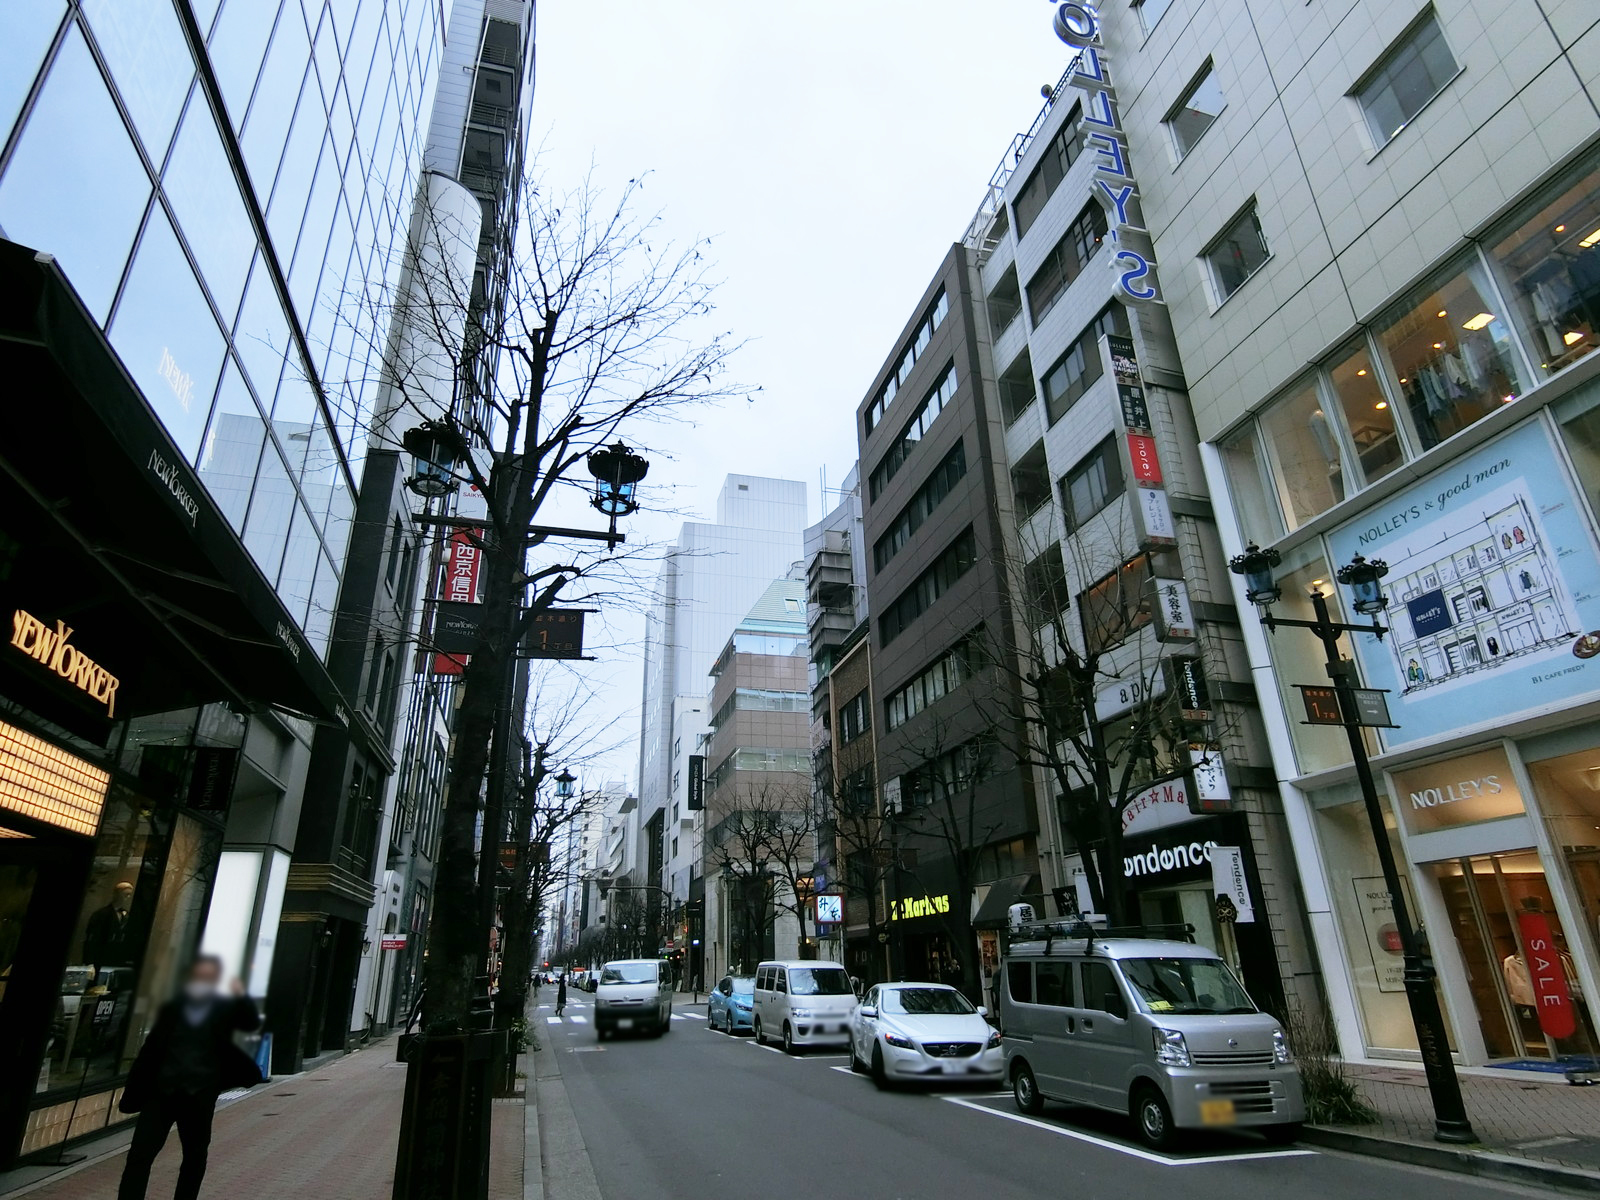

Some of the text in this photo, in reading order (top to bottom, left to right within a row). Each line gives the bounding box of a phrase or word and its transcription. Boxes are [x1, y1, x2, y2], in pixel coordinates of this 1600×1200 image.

[1358, 457, 1512, 547] NOLLEY'S & good man
[1166, 584, 1184, 623] 美容室
[1409, 775, 1502, 810] NOLLEY'S
[1123, 840, 1219, 877] endence
[1530, 939, 1561, 1006] SALE
[96, 1000, 115, 1016] OPEN
